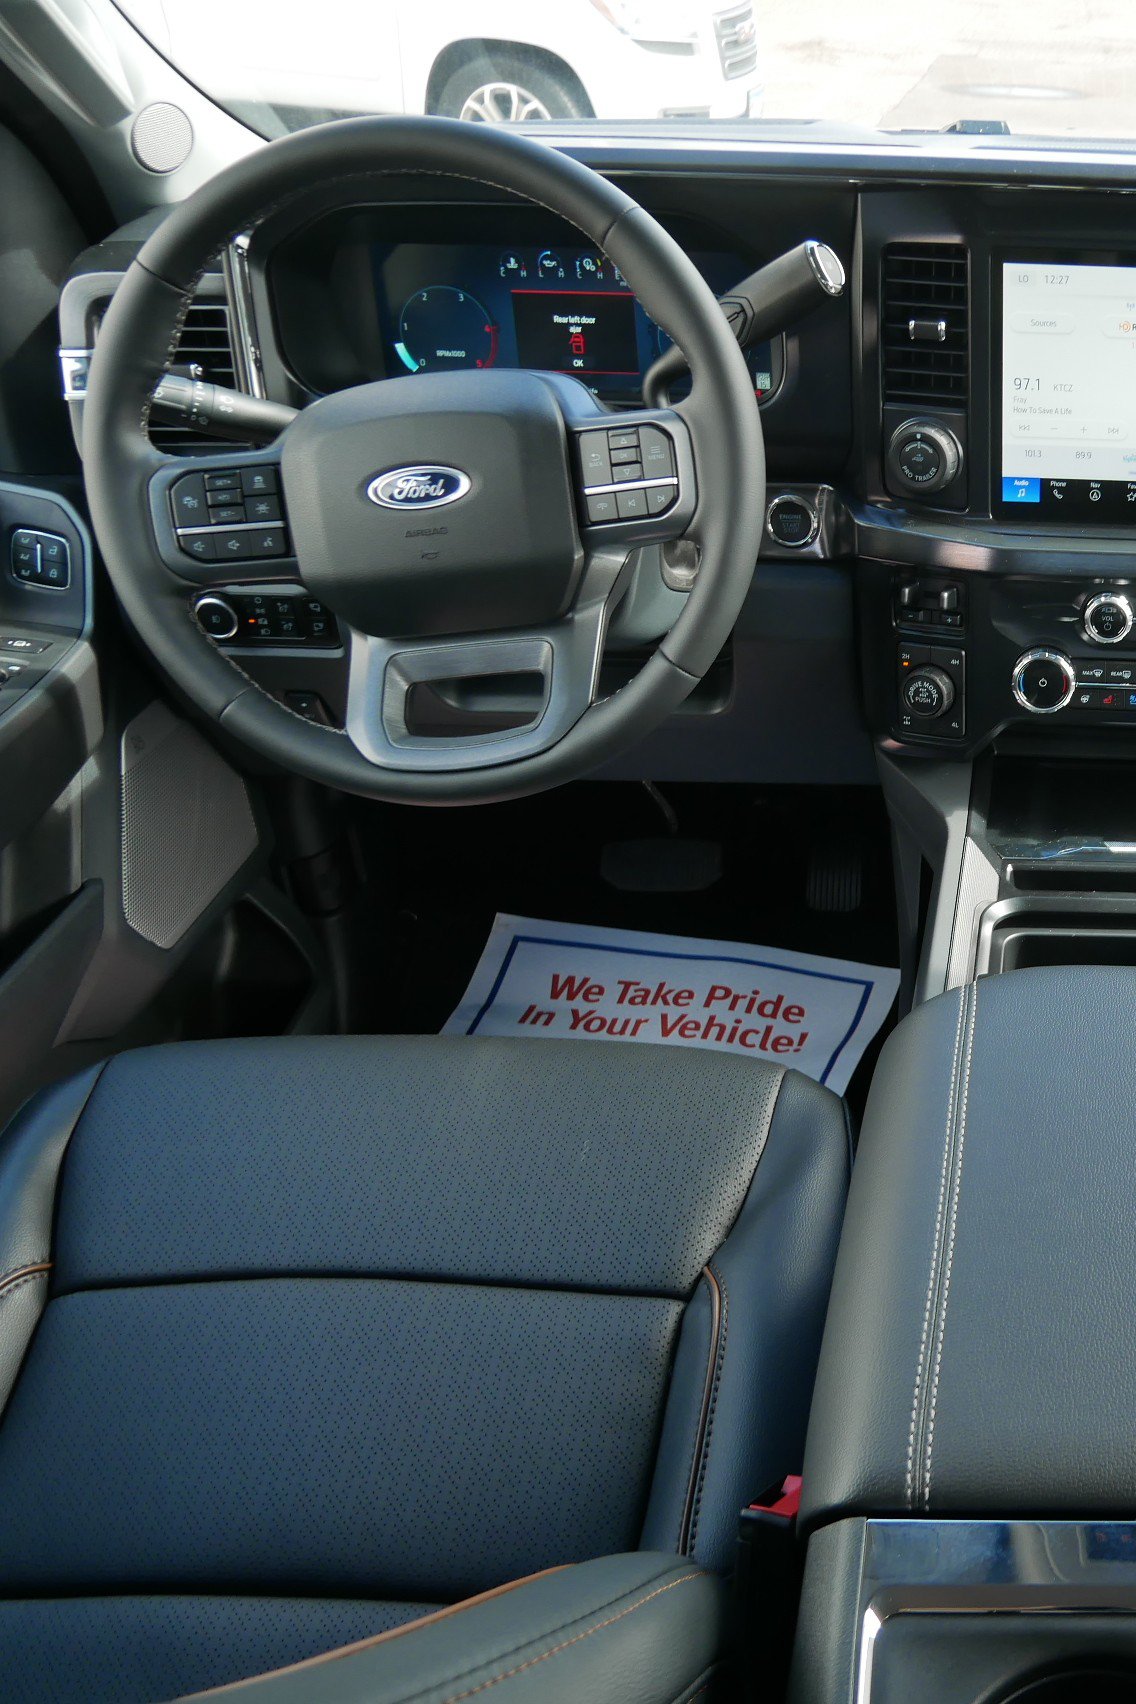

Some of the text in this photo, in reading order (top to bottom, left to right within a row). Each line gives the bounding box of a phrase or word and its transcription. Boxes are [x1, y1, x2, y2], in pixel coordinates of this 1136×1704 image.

[422, 293, 428, 301] 2
[458, 293, 465, 302] 3
[553, 315, 596, 324] Rear left door
[1030, 319, 1057, 328] Sources
[420, 358, 426, 367] 0
[573, 359, 584, 367] OK
[1013, 377, 1041, 391] 97.1
[1053, 384, 1074, 392] KTCZ
[1012, 406, 1028, 414] How
[1037, 407, 1053, 415] Save
[901, 465, 938, 482] PRO TRAILER
[393, 475, 445, 500] Ford
[1013, 479, 1029, 487] Audio
[1050, 480, 1067, 488] Phone
[405, 526, 448, 538] AIRBAG
[908, 681, 939, 698] DRIVE MODE
[915, 696, 931, 704] PUSH
[550, 973, 806, 1024] We Take Pride
[518, 1003, 809, 1054] In Your Vehicle!
